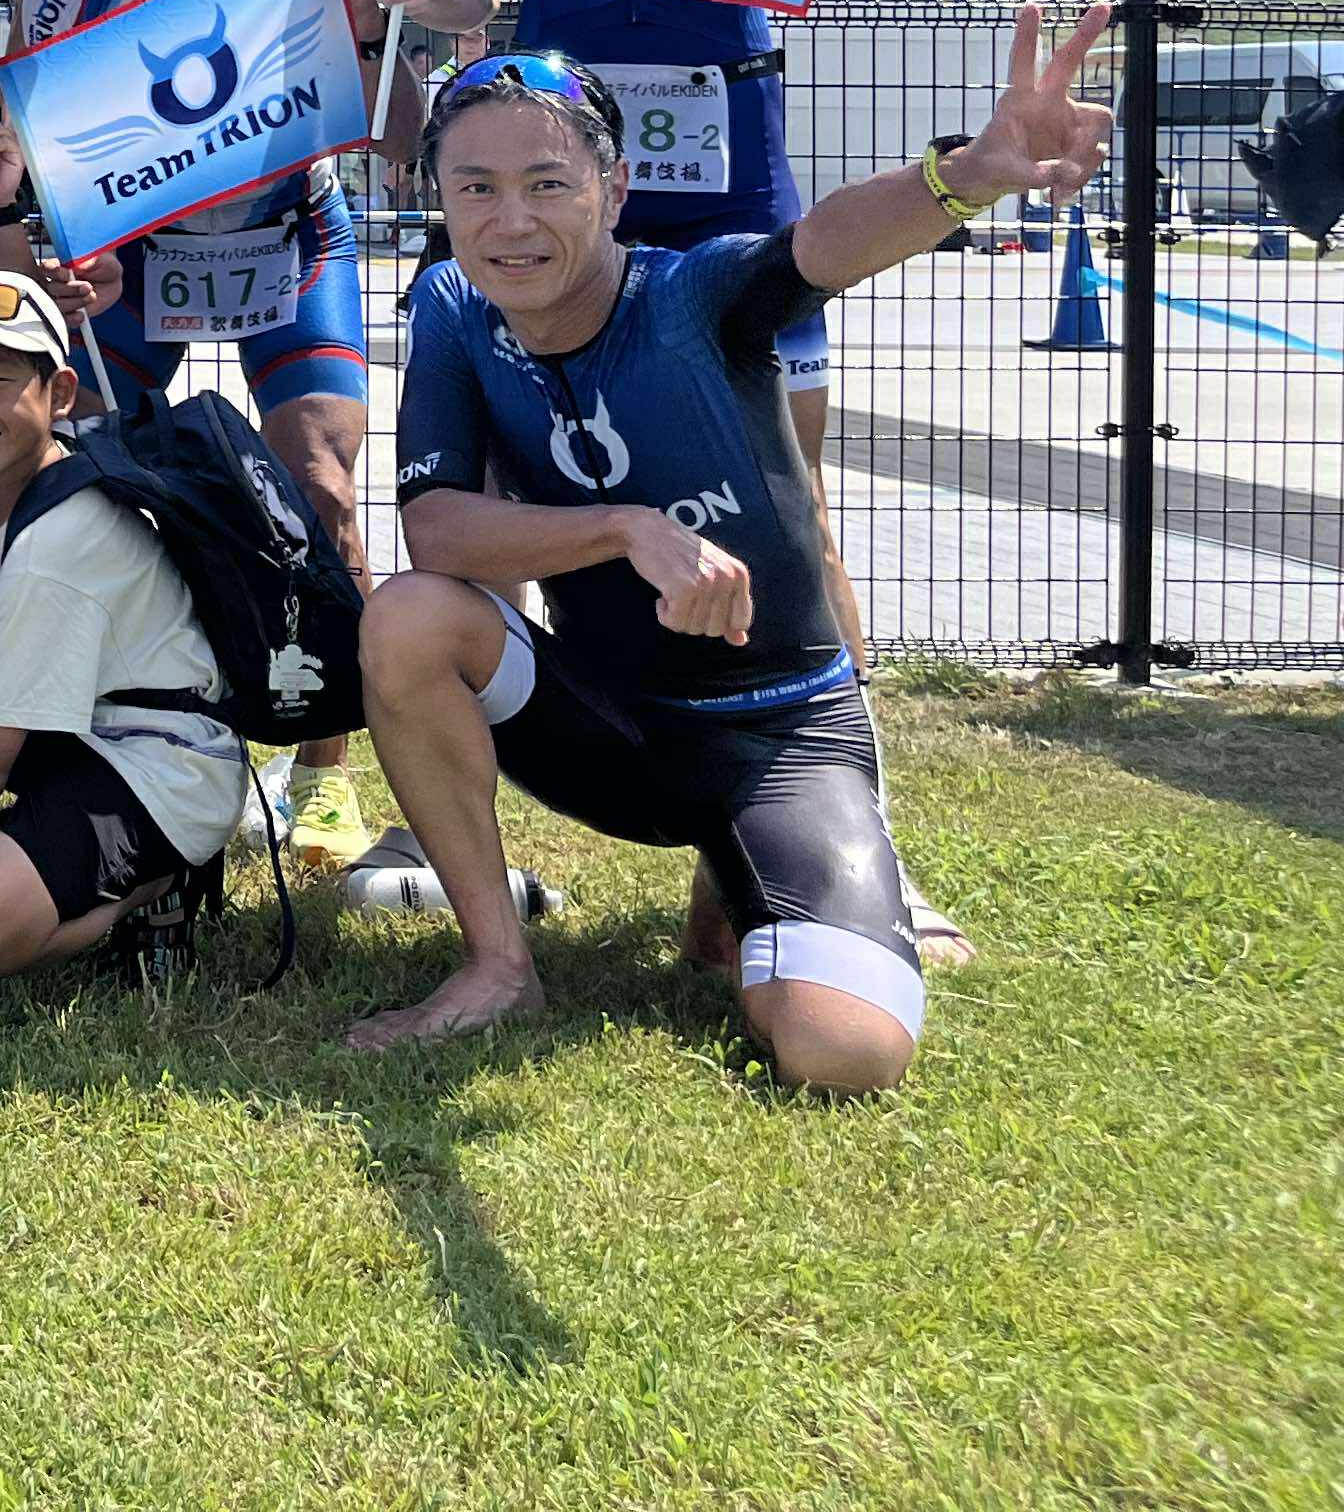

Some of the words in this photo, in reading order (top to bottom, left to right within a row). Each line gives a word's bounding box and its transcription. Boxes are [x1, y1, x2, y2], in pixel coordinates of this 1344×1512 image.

[93, 144, 197, 207] Team
[198, 76, 321, 158] TRION
[639, 108, 720, 152] 8-2
[160, 267, 292, 309] 617-2
